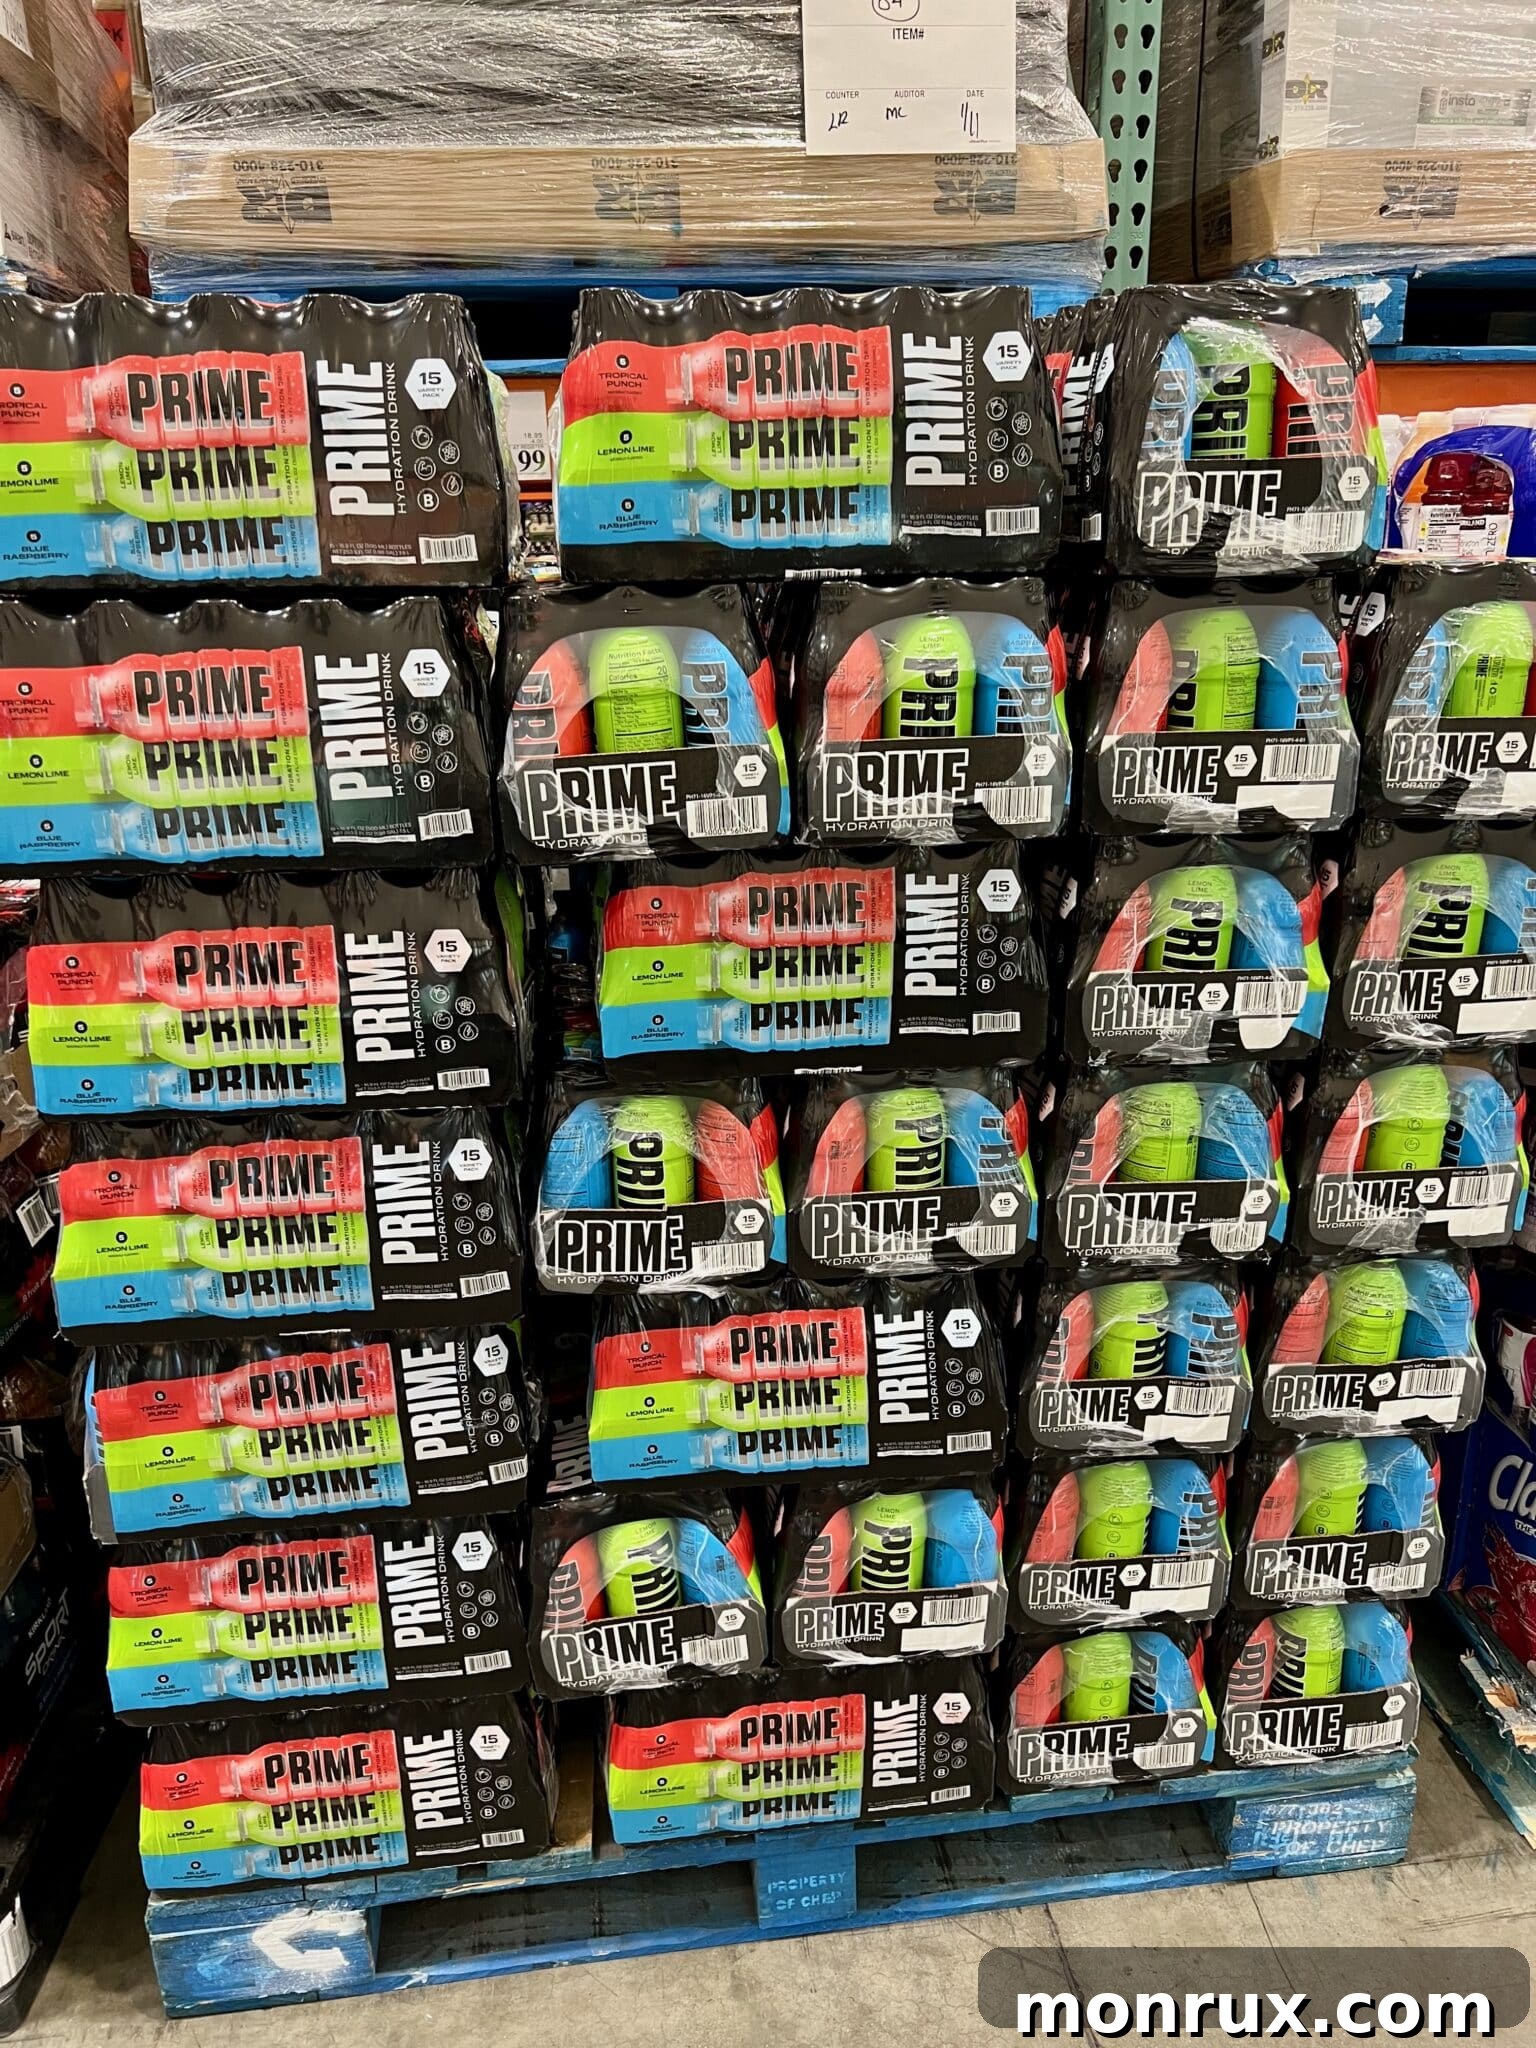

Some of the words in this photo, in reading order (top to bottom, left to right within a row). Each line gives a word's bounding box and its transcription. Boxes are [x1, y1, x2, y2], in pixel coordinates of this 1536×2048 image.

[892, 28, 924, 40] ITEM#
[894, 90, 925, 98] AUDITOR
[964, 335, 975, 386] DRINK
[997, 345, 1019, 358] 15
[385, 362, 398, 414] DRINK
[418, 372, 442, 385] 15
[599, 373, 648, 382] TROPICAL
[606, 379, 642, 388] PUNCH
[725, 346, 860, 403] PRIME
[1, 407, 40, 417] PUNCH
[126, 369, 276, 433] PRIME
[903, 333, 965, 486] PRIME
[316, 360, 395, 516] PRIME
[597, 447, 630, 457] LEMON
[631, 445, 655, 453] LIME
[729, 416, 860, 472] PRIME
[966, 391, 978, 486] HYDRATION
[34, 477, 59, 486] LIME
[136, 444, 283, 505] PRIME
[390, 418, 407, 514] HYDRATION
[1347, 476, 1361, 485] 15
[599, 519, 659, 530] RASPBERRY
[615, 514, 641, 523] BLUE
[731, 486, 860, 539] PRIME
[3, 552, 70, 561] RASPBERRY
[21, 545, 50, 555] BLUE
[147, 516, 287, 570] PRIME
[413, 662, 435, 675] 15
[657, 666, 668, 676] 20
[133, 665, 277, 725] PRIME
[314, 652, 395, 801] PRIME
[1505, 741, 1519, 749] 15
[144, 736, 282, 792] PRIME
[742, 763, 757, 772] 15
[1034, 754, 1046, 762] 15
[1112, 744, 1221, 798] PRIME
[1234, 754, 1248, 762] 15
[1387, 732, 1494, 782] PRIME
[524, 760, 680, 841] PRIME
[823, 749, 969, 822] PRIME
[825, 820, 913, 832] HYDRATION
[917, 817, 953, 827] DRIN
[961, 872, 970, 914] DRINK
[990, 881, 1010, 892] 15
[634, 912, 680, 920] TROPICAL
[640, 919, 673, 927] PUNCH
[747, 883, 866, 935] PRIME
[437, 941, 458, 953] 15
[905, 873, 959, 996] PRIME
[50, 970, 100, 980] TROPICAL
[172, 941, 307, 995] PRIME
[632, 973, 661, 981] LEMON
[663, 971, 684, 979] LIME
[750, 945, 865, 990] PRIME
[959, 918, 969, 997] HYDRATION
[344, 931, 414, 1063] PRIME
[1206, 991, 1220, 999] 15
[1457, 975, 1470, 983] 15
[750, 1000, 865, 1043] PRIME
[1091, 982, 1195, 1030] PRIME
[52, 1035, 85, 1043] LEMON
[181, 1006, 311, 1056] PRIME
[631, 1031, 685, 1040] RASPBERRY
[1092, 1029, 1152, 1037] HYDRATION
[189, 1064, 316, 1104] PRIME
[460, 1149, 481, 1161] 15
[207, 1152, 337, 1205] PRIME
[1424, 1184, 1438, 1192] 15
[373, 1141, 441, 1265] PRIME
[741, 1215, 756, 1224] 15
[997, 1198, 1013, 1207] 15
[1065, 1192, 1197, 1248] PRIME
[1318, 1178, 1413, 1224] PRIME
[216, 1213, 340, 1259] PRIME
[555, 1214, 687, 1276] PRIME
[811, 1197, 942, 1259] PRIME
[96, 1246, 125, 1254] LEMON
[127, 1244, 149, 1252] LIME
[729, 1320, 841, 1370] PRIME
[953, 1319, 971, 1330] 15
[484, 1346, 501, 1358] 15
[874, 1310, 931, 1424] PRIME
[249, 1360, 369, 1419] PRIME
[401, 1342, 469, 1461] PRIME
[734, 1376, 843, 1422] PRIME
[1038, 1387, 1132, 1429] PRIME
[1141, 1392, 1155, 1400] 15
[1271, 1373, 1366, 1414] PRIME
[625, 1408, 653, 1418] LEMON
[655, 1406, 675, 1414] LIME
[268, 1464, 384, 1510] PRIME
[462, 1542, 481, 1553] 15
[236, 1550, 351, 1602] PRIME
[1028, 1565, 1116, 1605] PRIME
[1127, 1569, 1139, 1577] 15
[1251, 1543, 1368, 1595] PRIME
[384, 1536, 446, 1649] PRIME
[896, 1607, 910, 1615] 15
[244, 1604, 353, 1649] PRIME
[725, 1613, 738, 1622] 15
[795, 1603, 886, 1644] PRIME
[550, 1617, 677, 1682] PRIME
[944, 1702, 962, 1712] 15
[1179, 1722, 1191, 1730] 15
[481, 1734, 498, 1744] 15
[740, 1707, 841, 1752] PRIME
[872, 1694, 919, 1788] PRIME
[1016, 1723, 1131, 1777] PRIME
[1229, 1704, 1344, 1756] PRIME
[264, 1743, 373, 1795] PRIME
[404, 1730, 465, 1830] PRIME
[742, 1754, 840, 1791] PRIME
[768, 1872, 848, 1894] PROPERTY
